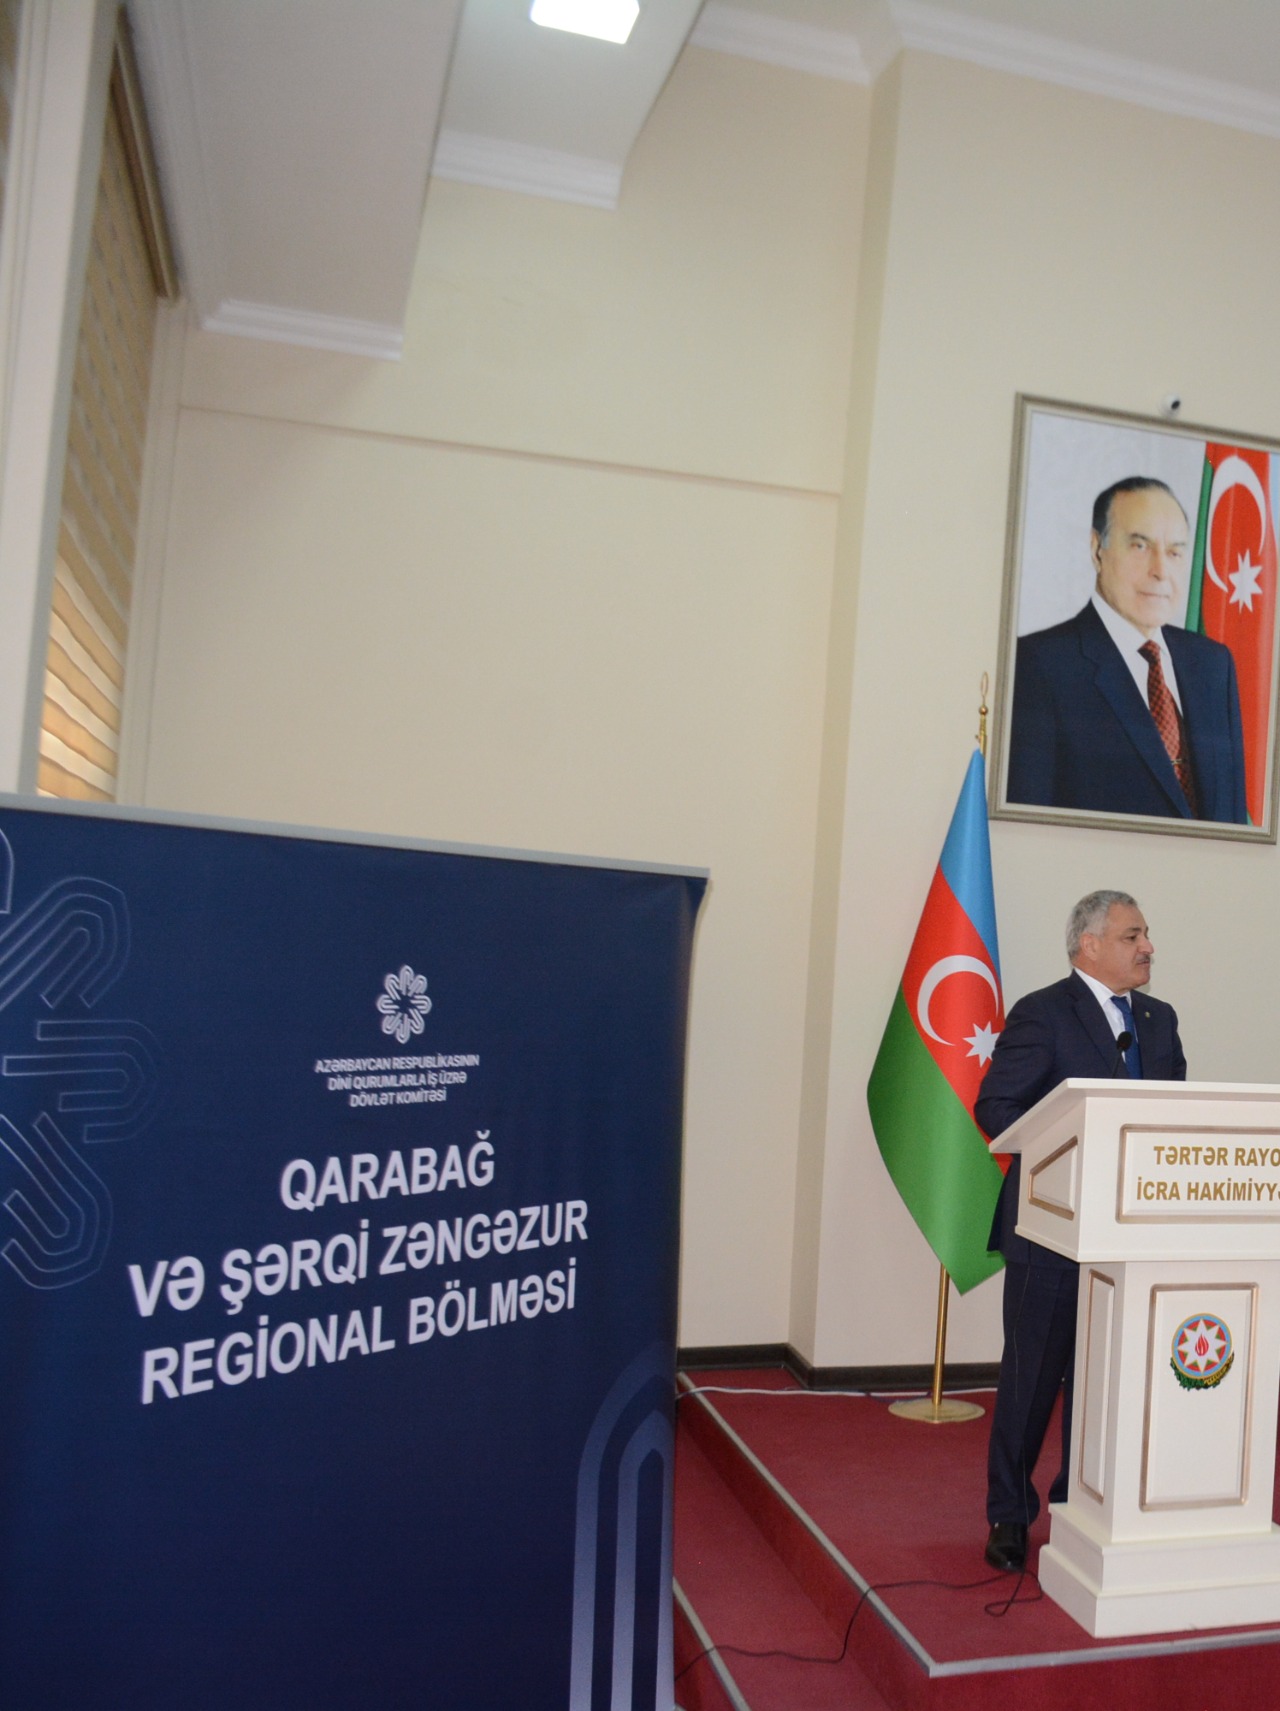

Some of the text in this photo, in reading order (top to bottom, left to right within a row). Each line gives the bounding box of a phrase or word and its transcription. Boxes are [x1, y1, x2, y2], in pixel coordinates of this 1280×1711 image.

[315, 1053, 480, 1073] AZƏRBAYCAN RESPUBLİKASININ
[328, 1070, 467, 1091] DİNİ QURUMLARLA İŞ ÜZRƏ
[350, 1087, 447, 1107] DÖVLƏT KOMİTƏSİ
[1153, 1145, 1228, 1166] TƏRTƏR
[280, 1130, 494, 1211] QARABAĞ
[1136, 1177, 1181, 1201] İCRA
[128, 1199, 588, 1317] VƏ ŞƏRQİ ZƏNGƏZUR
[142, 1257, 577, 1404] REGİONAL BÖLMƏSİ
